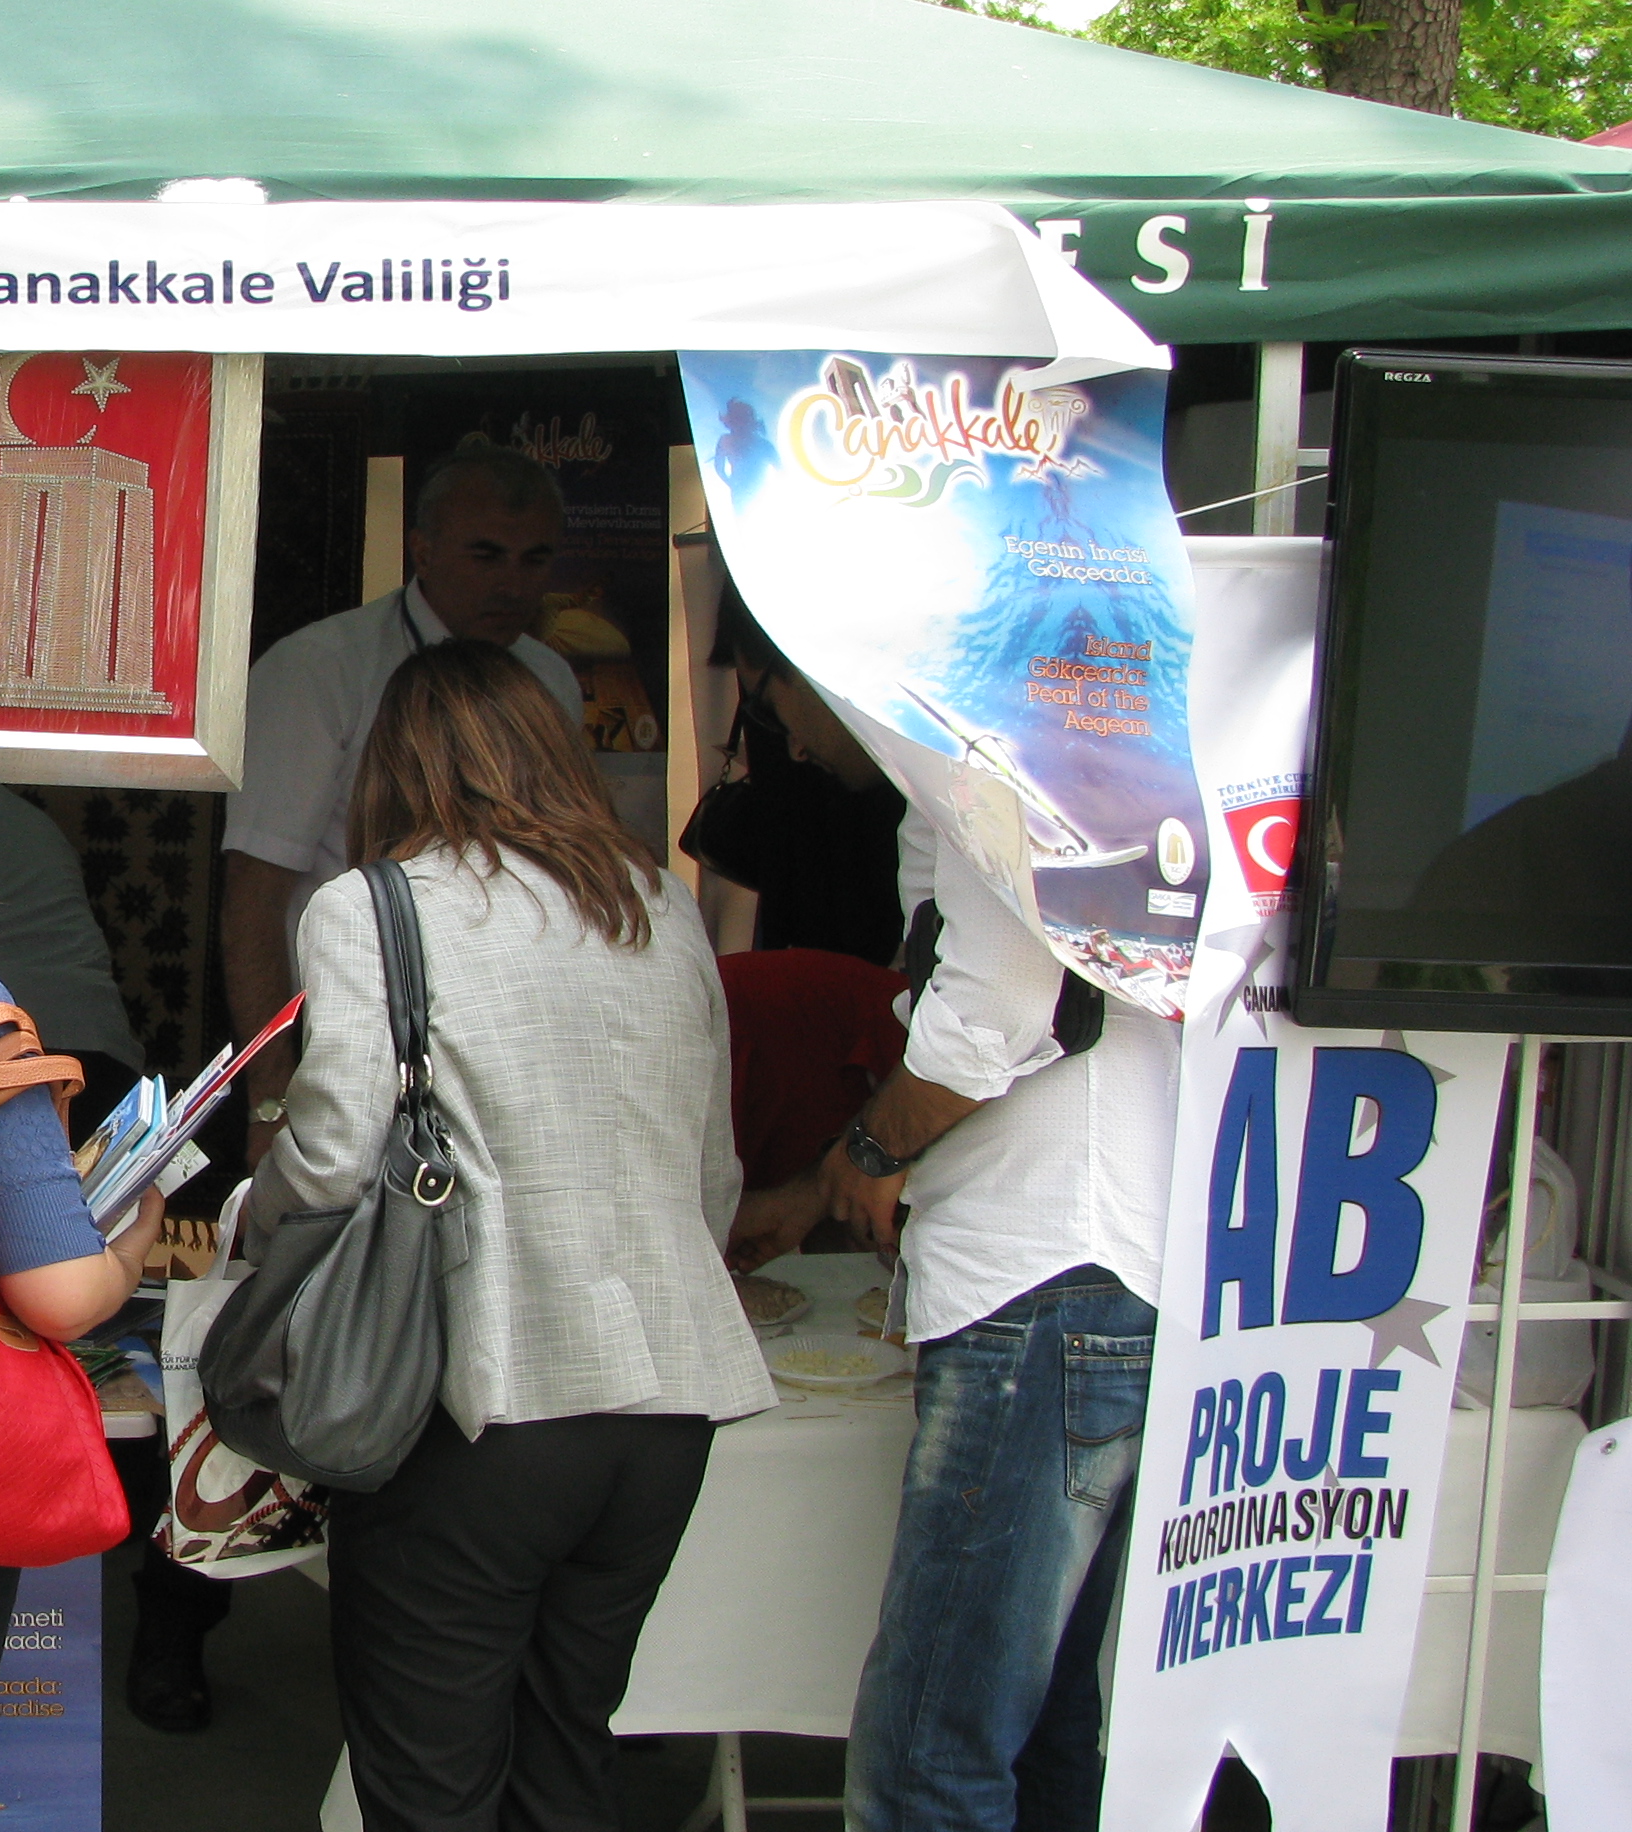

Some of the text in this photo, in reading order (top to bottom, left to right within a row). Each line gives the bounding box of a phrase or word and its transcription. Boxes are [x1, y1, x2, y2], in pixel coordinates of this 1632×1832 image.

[296, 257, 510, 312] Valiliği
[1384, 371, 1432, 383] REGZA
[1003, 535, 1150, 564] Egenin İncisi
[1028, 558, 1153, 584] Gökçeada:
[1026, 681, 1149, 711] Pearl of the
[1064, 710, 1152, 737] Aegean
[1217, 775, 1282, 797] TÜRKİYE
[1221, 790, 1268, 807] AVRUPA
[1200, 1046, 1438, 1340] AB
[1179, 1369, 1401, 1506] PROJE
[1157, 1485, 1409, 1575] KOORDİNASYON
[1155, 1537, 1374, 1673] MERKEZİ
